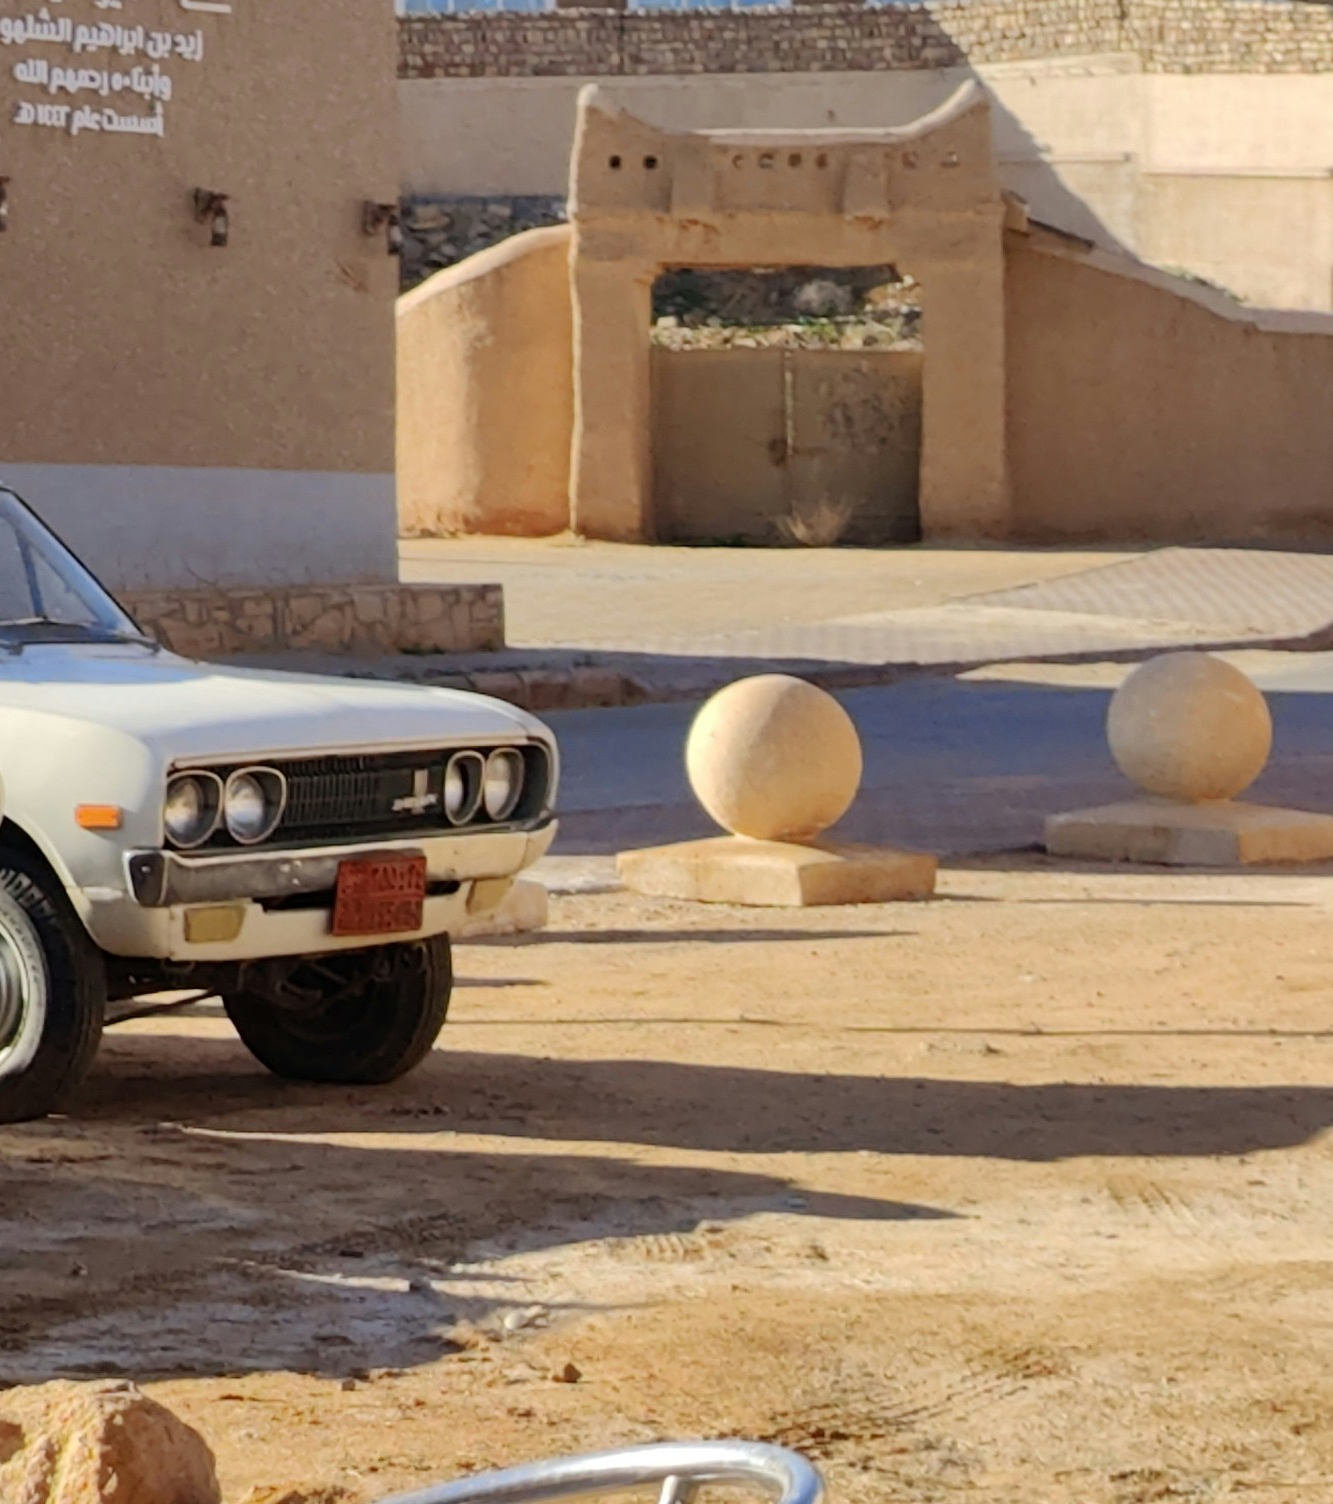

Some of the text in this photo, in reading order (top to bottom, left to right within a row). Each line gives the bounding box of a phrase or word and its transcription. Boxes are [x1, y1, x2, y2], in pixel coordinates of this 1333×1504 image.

[145, 31, 172, 59] بن
[174, 29, 204, 62] زيد
[13, 58, 48, 85] الله
